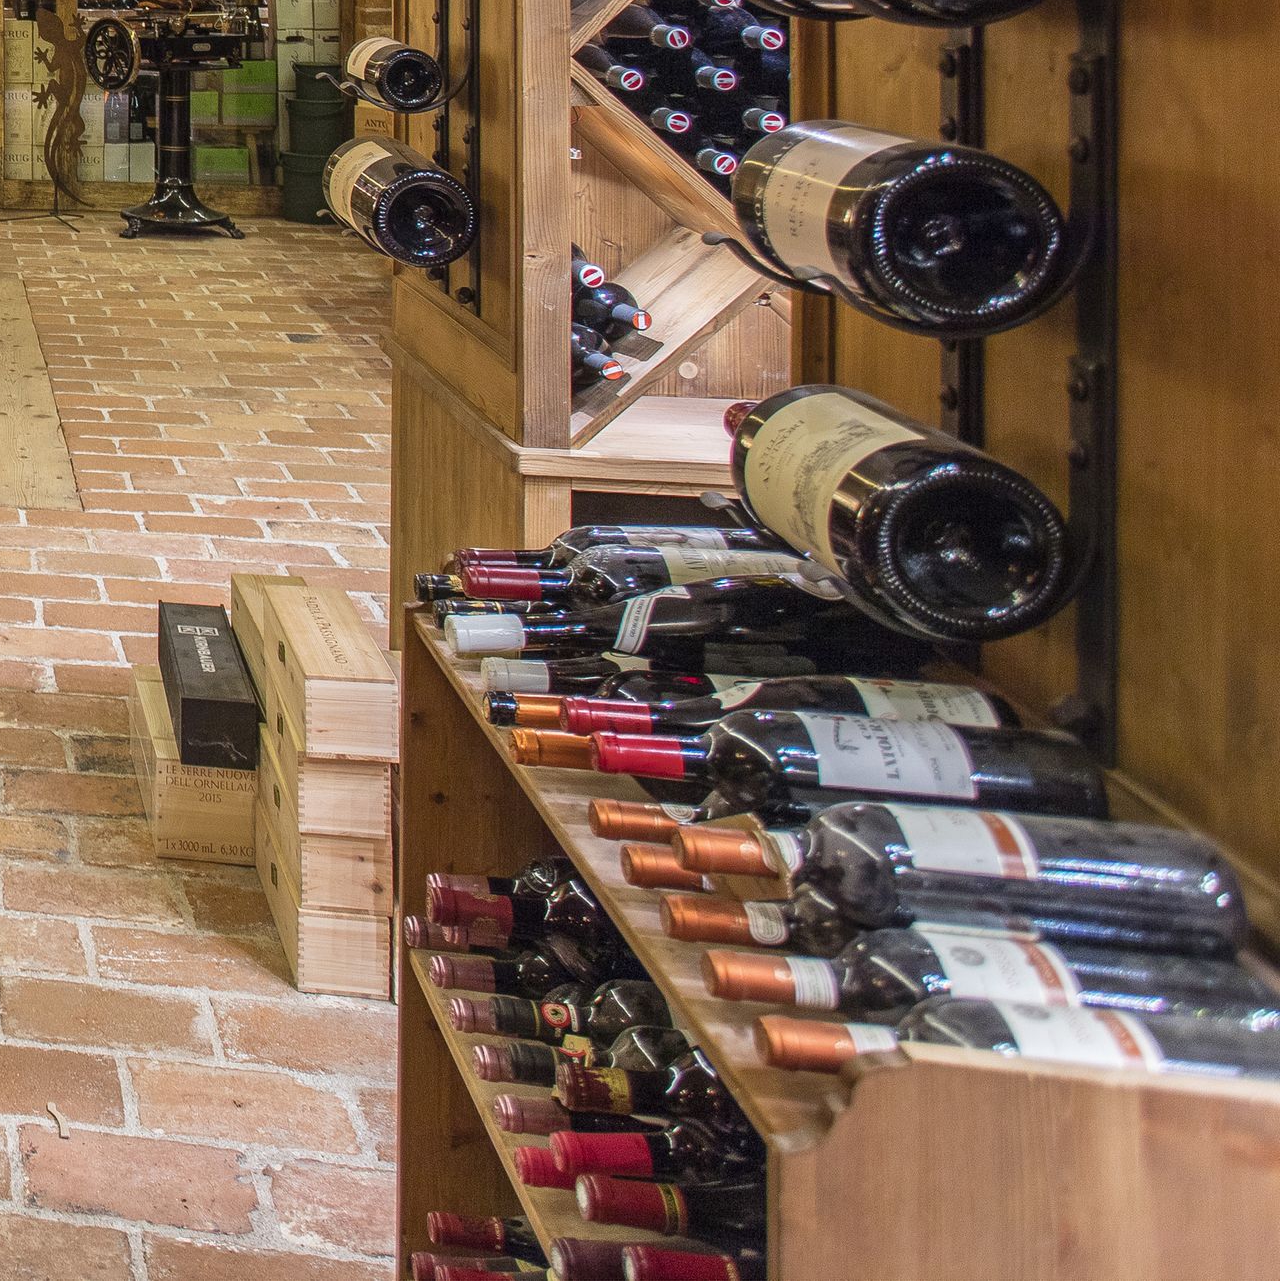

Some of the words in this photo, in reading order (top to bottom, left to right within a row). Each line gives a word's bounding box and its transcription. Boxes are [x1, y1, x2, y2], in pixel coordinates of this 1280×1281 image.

[193, 634, 216, 673] KIRNBAUER
[165, 764, 179, 775] LE
[180, 766, 215, 778] SERRE
[215, 768, 257, 782] NUOVE
[165, 775, 193, 788] DELL'
[193, 779, 257, 794] ORNELLAIA
[198, 791, 223, 804] 2015
[177, 840, 200, 853] 3000
[200, 841, 217, 854] mL
[239, 846, 255, 858] KG
